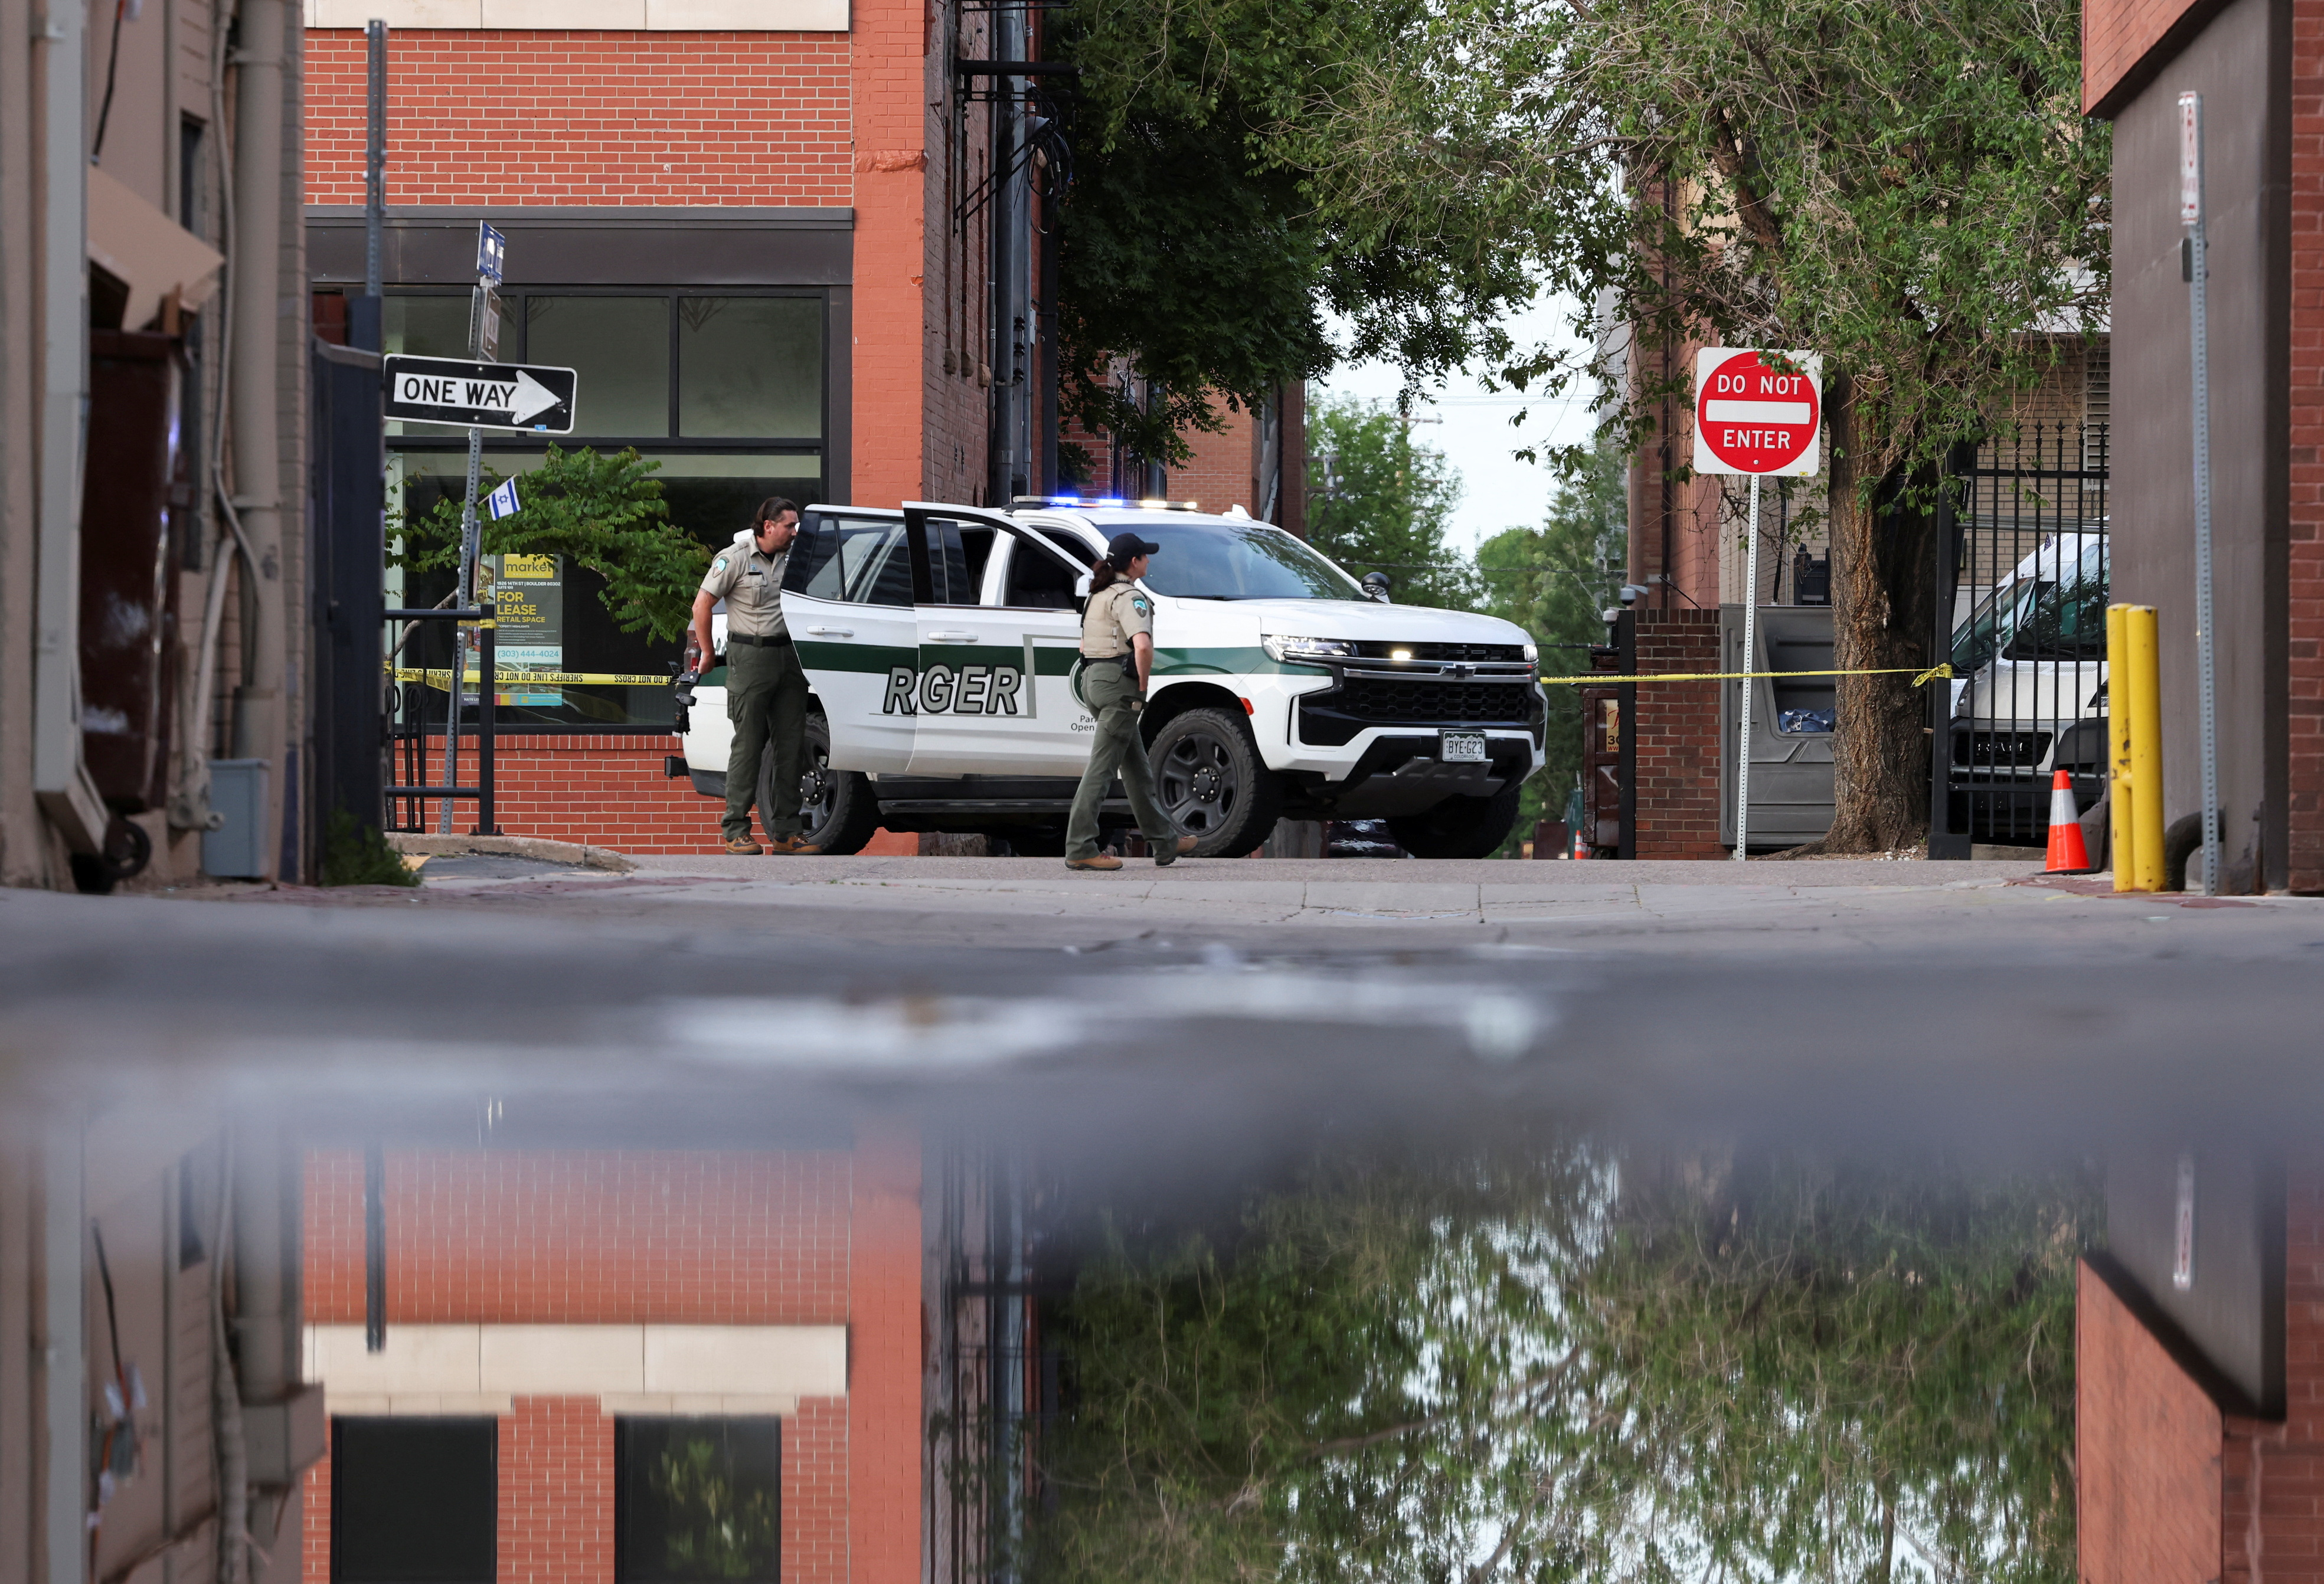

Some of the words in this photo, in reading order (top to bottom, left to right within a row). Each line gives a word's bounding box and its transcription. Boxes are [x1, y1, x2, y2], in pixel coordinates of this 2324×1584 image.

[1718, 375, 1746, 394] DO
[1760, 376, 1802, 395] NOT
[404, 377, 456, 404] ONE
[466, 382, 517, 408] WAY
[1723, 429, 1791, 449] ENTER
[497, 591, 524, 602] FOR
[497, 604, 537, 615] LEASE
[498, 650, 519, 659] (303)
[505, 672, 519, 680] NOT
[521, 672, 531, 680] DO
[533, 673, 547, 681] LINE
[550, 673, 583, 682] SHERIFF'S
[614, 675, 636, 683] CROSS
[1071, 722, 1094, 732] Open
